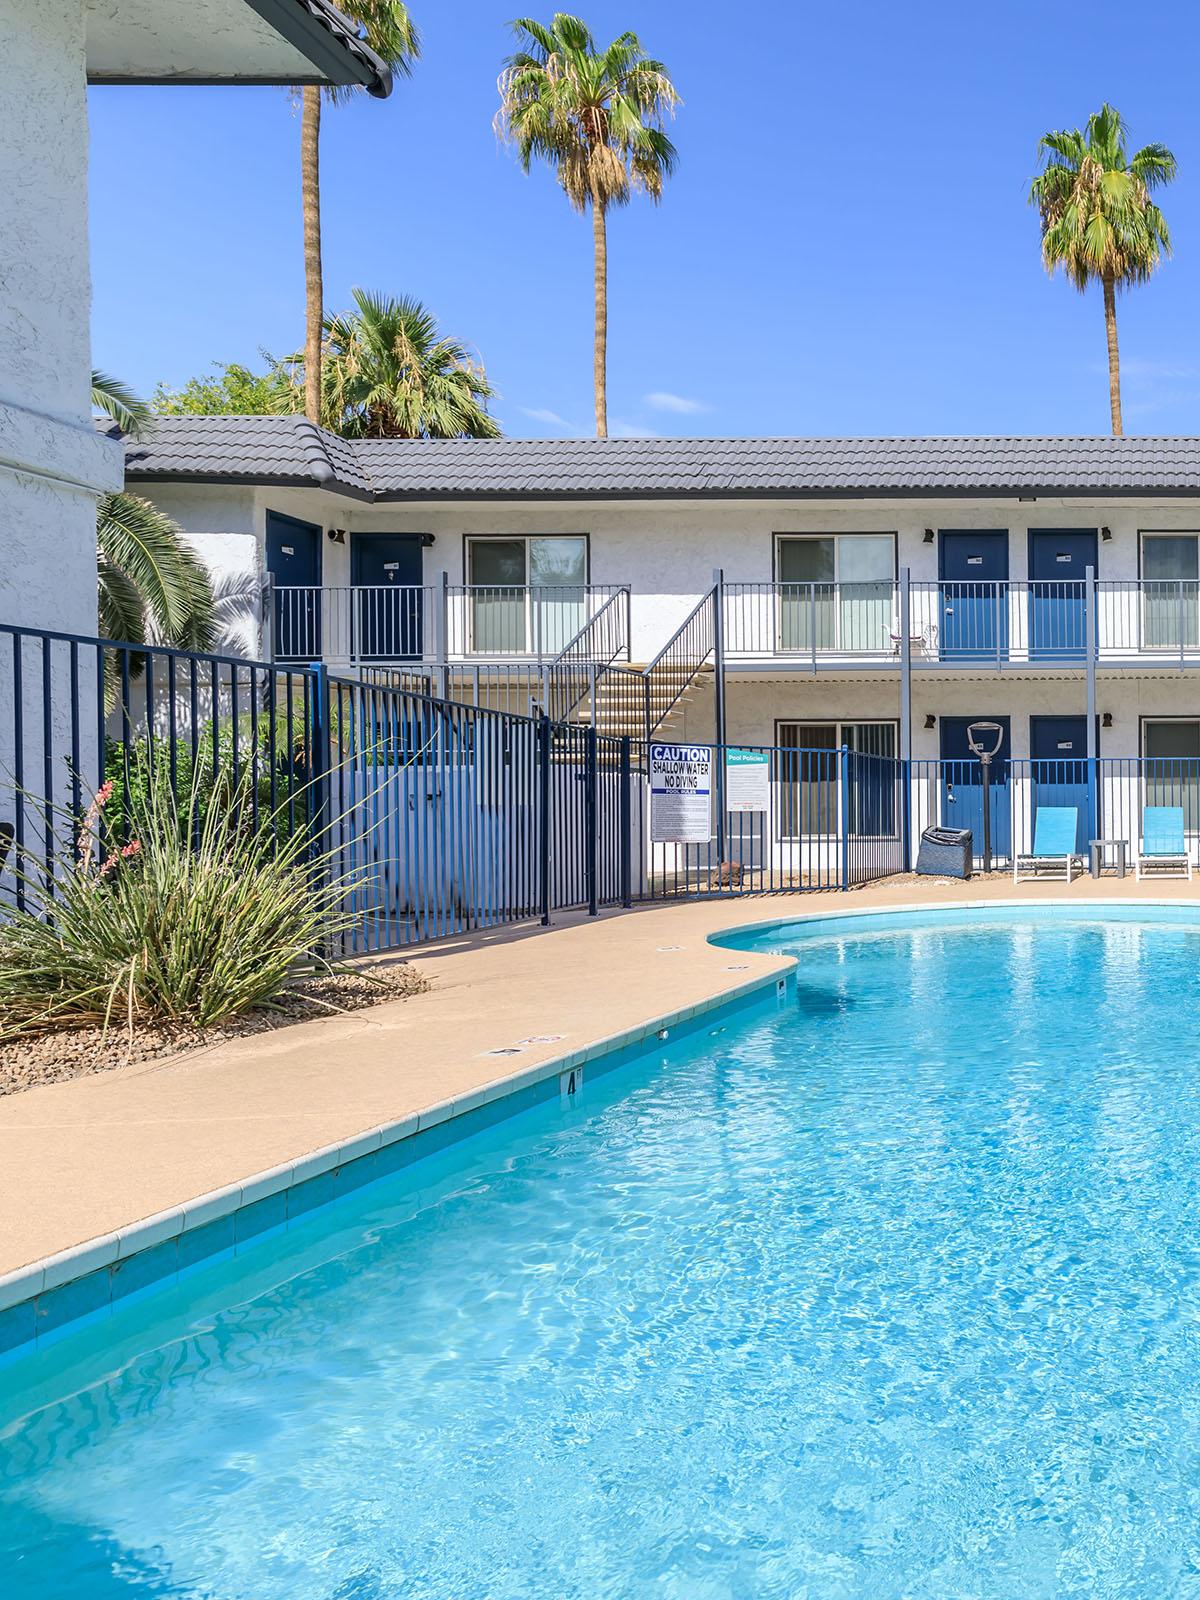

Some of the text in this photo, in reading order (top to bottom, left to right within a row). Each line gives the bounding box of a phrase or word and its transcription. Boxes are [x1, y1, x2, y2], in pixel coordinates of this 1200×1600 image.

[653, 747, 709, 762] CAUTION
[742, 754, 763, 762] Policies
[653, 761, 709, 775] SHALLOW WATER
[664, 775, 698, 789] NO DIVING
[567, 1070, 577, 1096] 4
